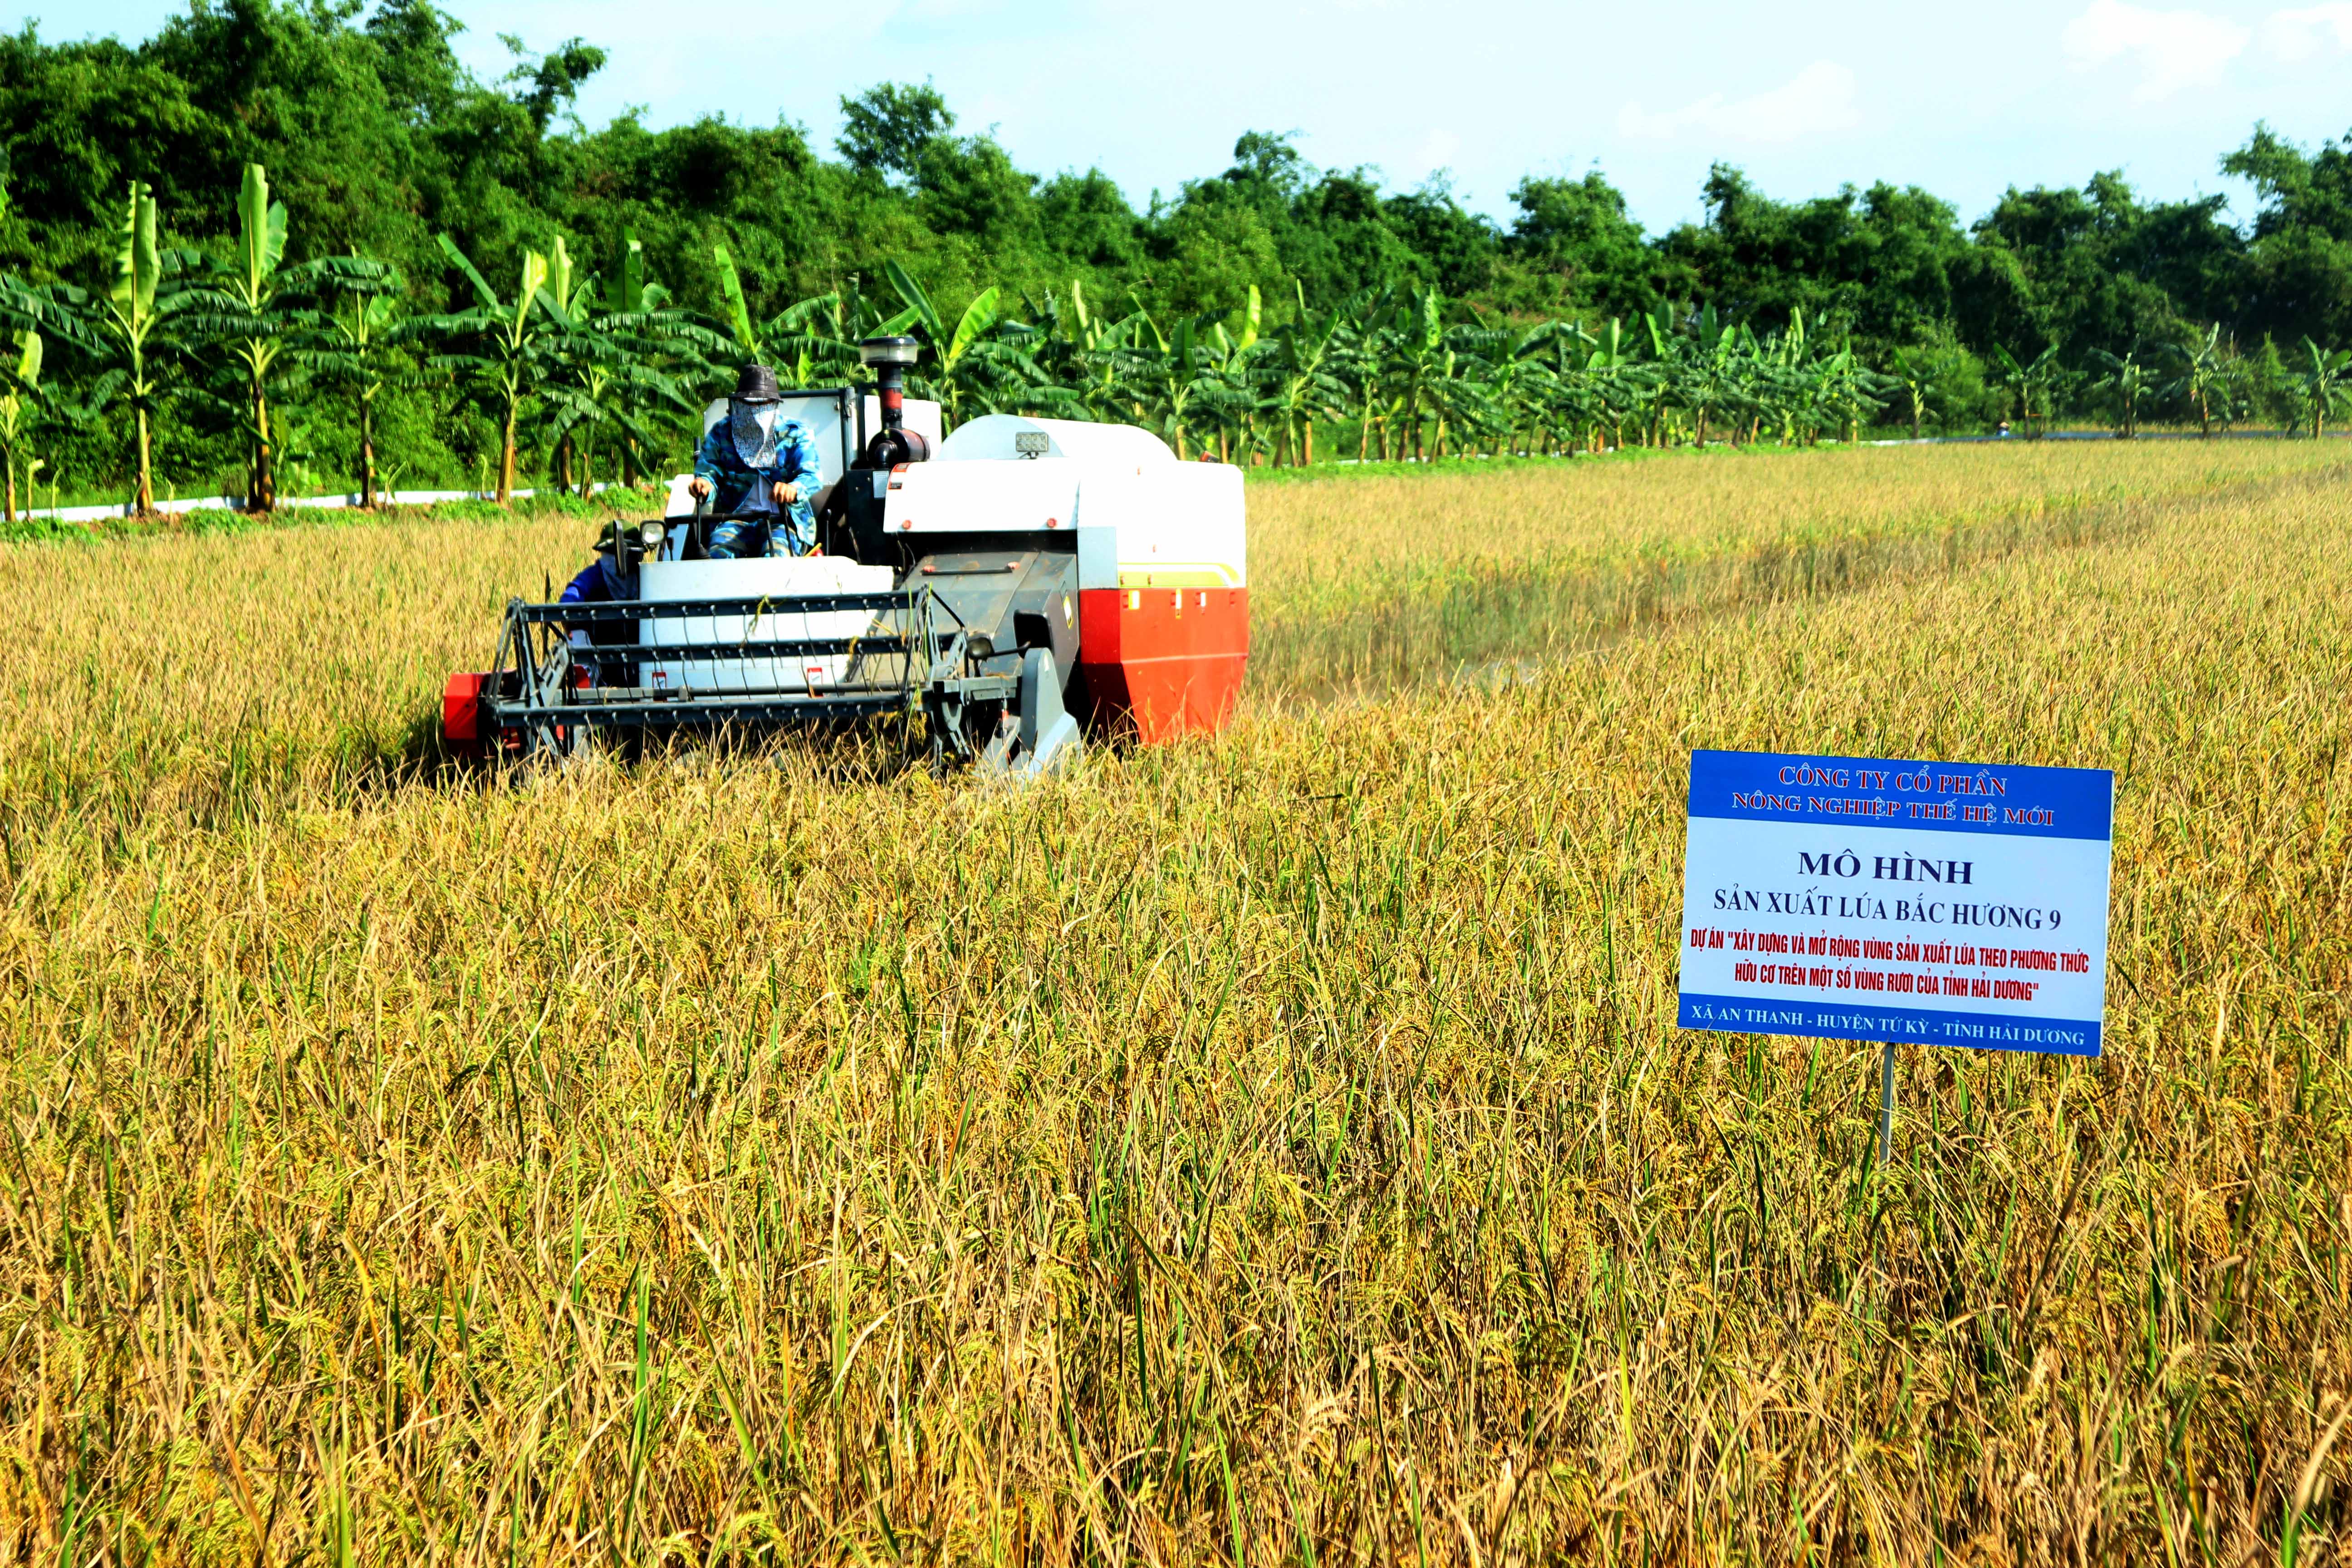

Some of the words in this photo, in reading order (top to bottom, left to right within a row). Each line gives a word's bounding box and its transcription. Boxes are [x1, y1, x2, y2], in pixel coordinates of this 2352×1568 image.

[1779, 762, 1850, 788] CÔNG
[1856, 770, 1890, 789] TY
[1896, 765, 1931, 792] CỔ
[1937, 769, 2007, 796] PHẦN
[1732, 789, 1801, 811] NÔNG
[1808, 796, 1901, 820] NGHIỆP
[1906, 798, 1957, 820] THẾ
[1962, 803, 1996, 826] HỆ
[2003, 805, 2054, 826] MỚI
[1797, 848, 1861, 877] MÔ
[1872, 851, 1974, 885] HÌNH
[1714, 883, 1760, 911] SẢN
[1766, 886, 1833, 916] XUẤT
[1839, 892, 1887, 920] LÚA
[1895, 893, 1945, 923] BẮC
[1951, 902, 2042, 930] HƯƠNG
[2049, 910, 2061, 930] 9
[1690, 928, 1707, 951] DỰ
[1708, 926, 1724, 949] ÁN
[1728, 928, 1755, 951] "XÂY
[1758, 932, 1788, 956] DỰNG
[1792, 932, 1805, 954] VÀ
[1808, 930, 1827, 956] MỞ
[1829, 935, 1859, 961] RỘNG
[1863, 936, 1893, 960] VÙNG
[1896, 935, 1919, 962] SẢN
[1922, 938, 1951, 964] XUẤT
[1954, 942, 1975, 965] LÚA
[1979, 947, 2007, 967] THEO
[2010, 949, 2057, 971] PHƯƠNG
[2060, 949, 2089, 973] THỨC
[1735, 959, 1757, 982] HỮU
[1760, 964, 1776, 983] CƠ
[1779, 963, 1806, 985] TRÊN
[1809, 965, 1833, 991] MỘT
[1836, 964, 1852, 989] SỐ
[1855, 967, 1883, 991] VÙNG
[1887, 972, 1913, 993] RƯƠI
[1917, 967, 1939, 995] CỦA
[1943, 970, 1968, 996] TỈNH
[1971, 971, 1990, 998] HẢI
[1994, 979, 2039, 1000] DƯƠNG"
[1691, 1004, 1713, 1019] XÃ
[1718, 1008, 1740, 1020] AN
[1745, 1009, 1803, 1025] THANH
[1817, 1014, 1874, 1033] HUYỆN
[1879, 1016, 1903, 1033] TỨ
[1906, 1018, 1929, 1034] KỲ
[1943, 1020, 1984, 1038] TỈNH
[1989, 1023, 2019, 1040] HẢI
[2024, 1029, 2085, 1045] DƯƠNG
